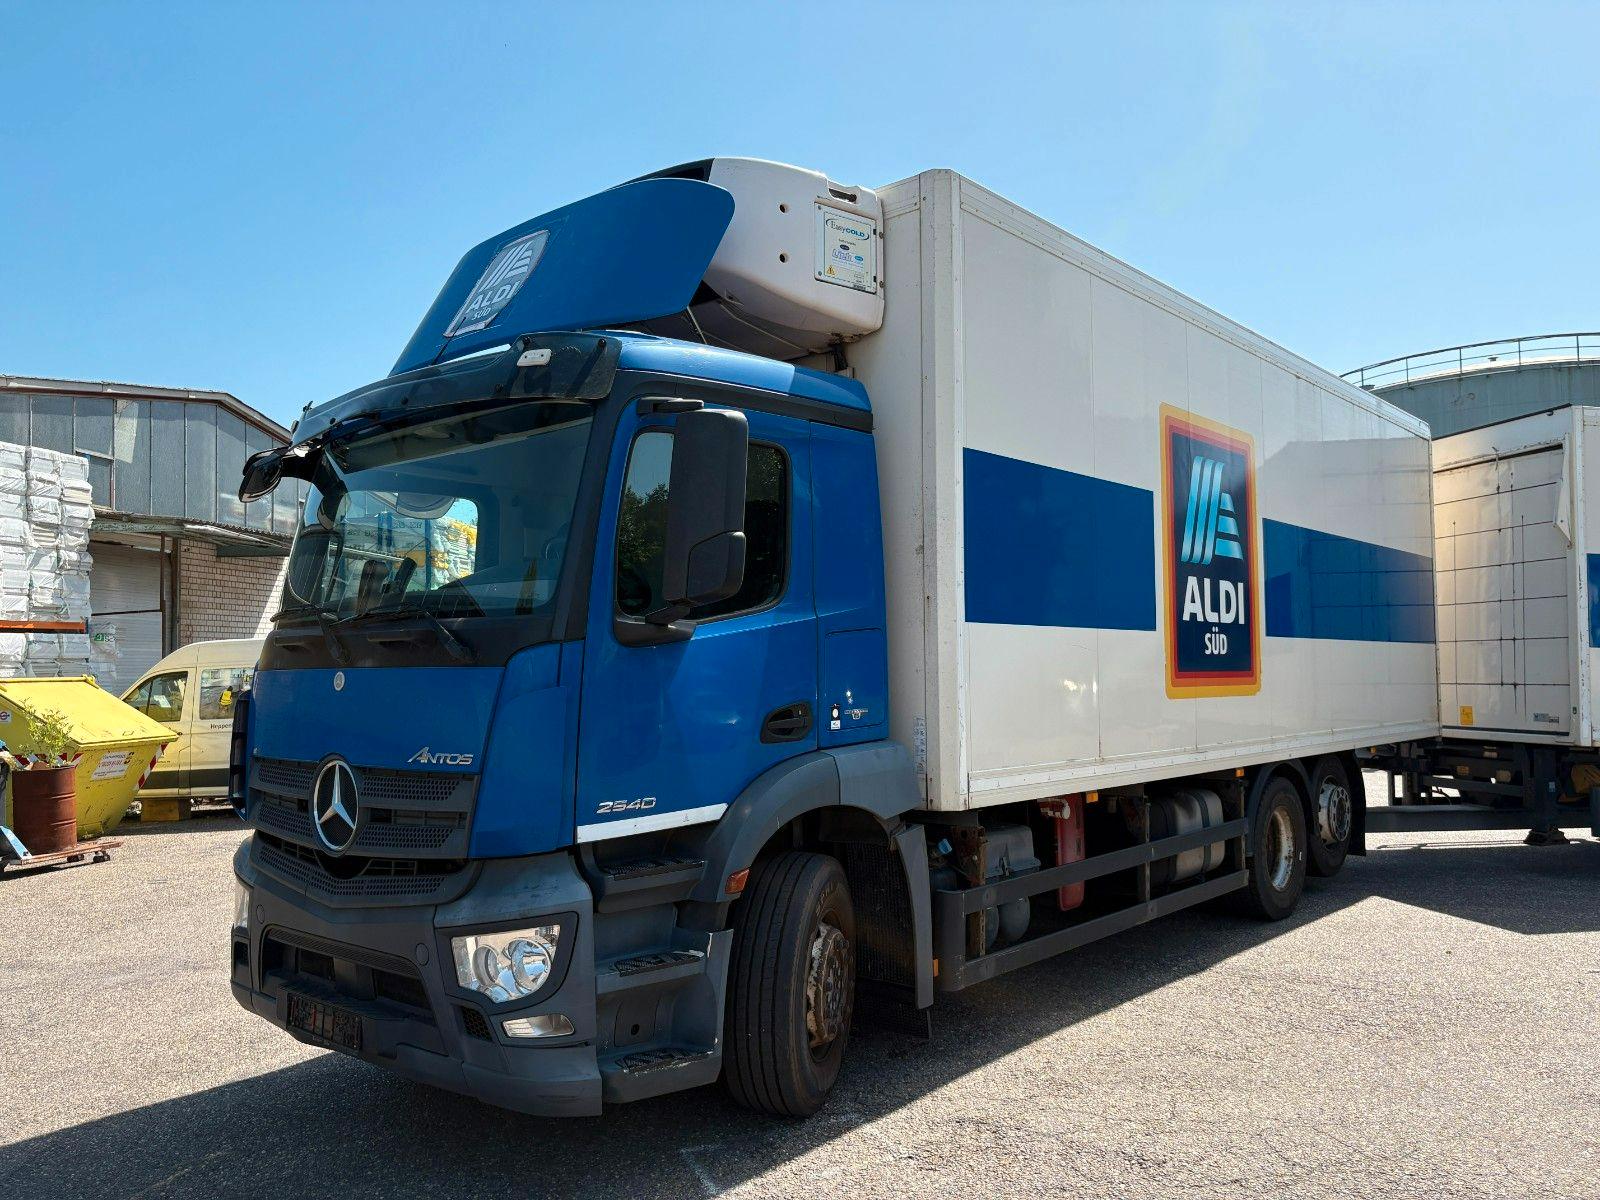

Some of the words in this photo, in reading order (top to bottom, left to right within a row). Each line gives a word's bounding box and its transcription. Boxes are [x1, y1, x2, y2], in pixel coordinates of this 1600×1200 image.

[465, 281, 521, 314] ALDI
[1182, 575, 1245, 625] ALDI
[1204, 626, 1228, 655] SÜD
[407, 746, 474, 765] ANTOS
[596, 797, 657, 814] 2540
